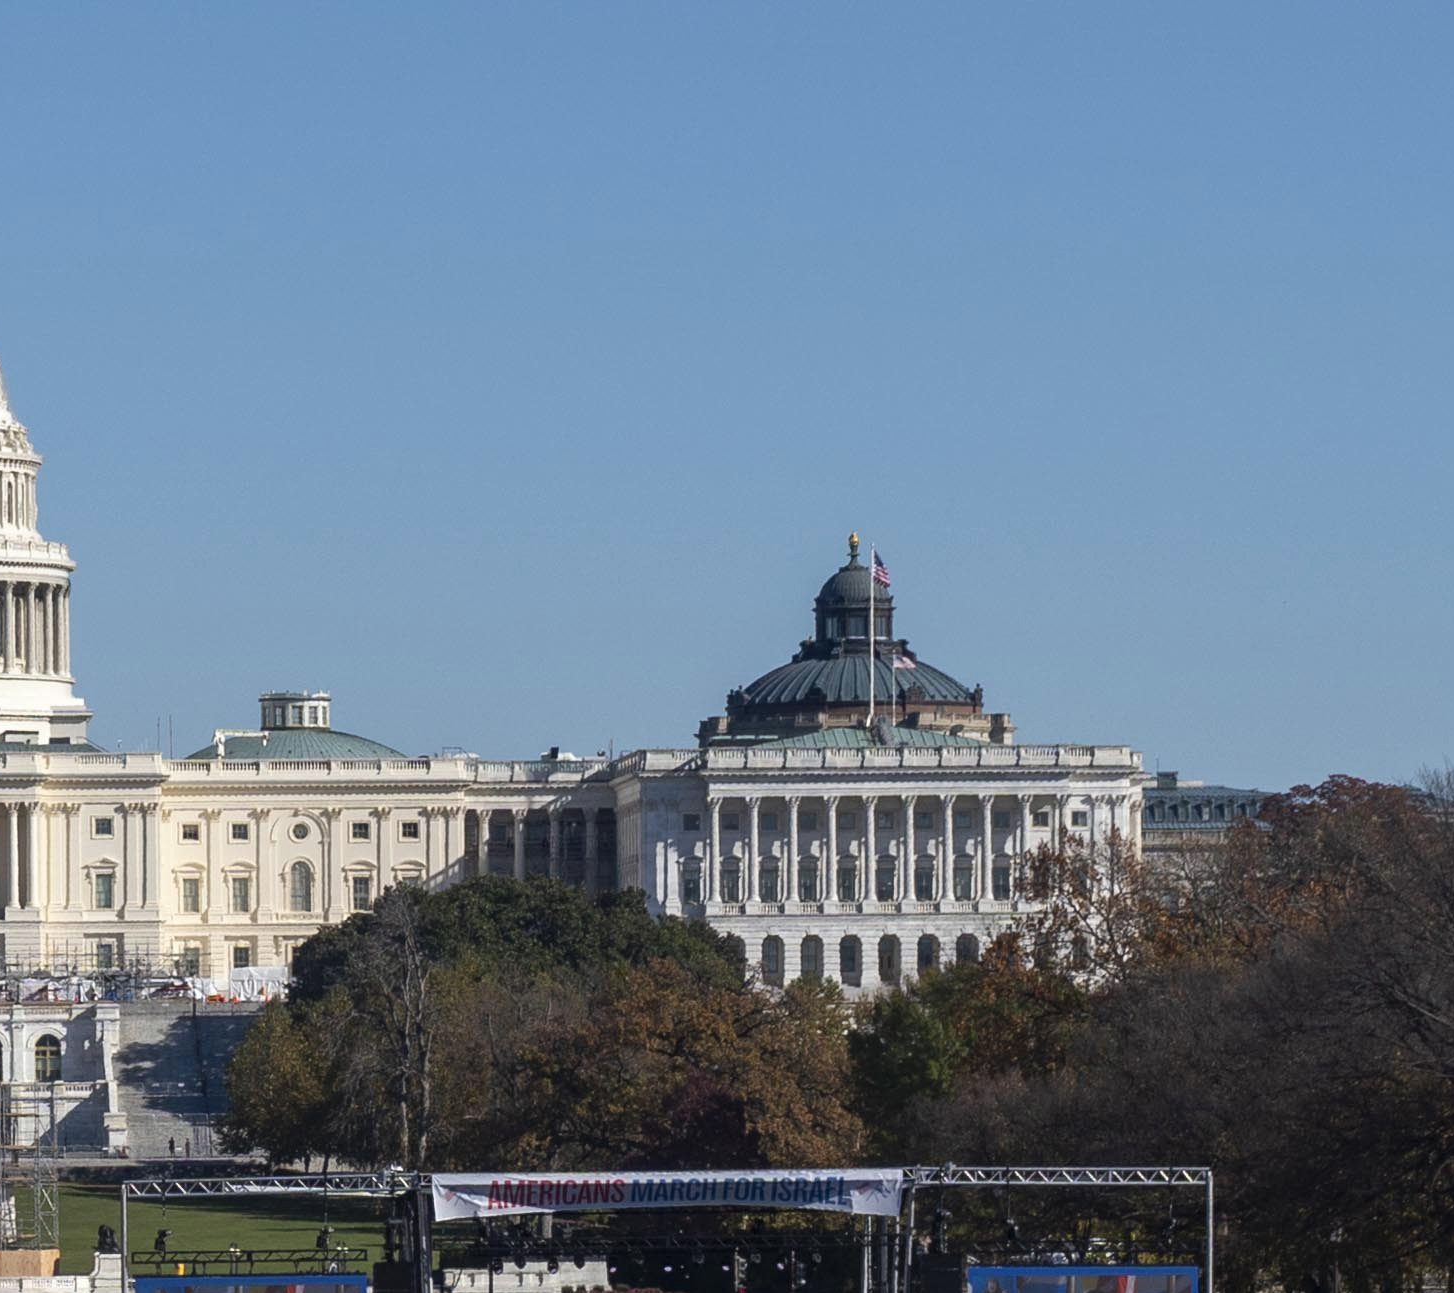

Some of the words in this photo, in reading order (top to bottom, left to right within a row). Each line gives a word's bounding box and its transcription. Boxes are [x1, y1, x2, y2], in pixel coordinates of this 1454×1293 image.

[488, 1180, 626, 1209] AMERICANS
[631, 1178, 717, 1203] MARCH
[723, 1178, 769, 1201] FOR
[771, 1176, 847, 1205] ISRAEL
